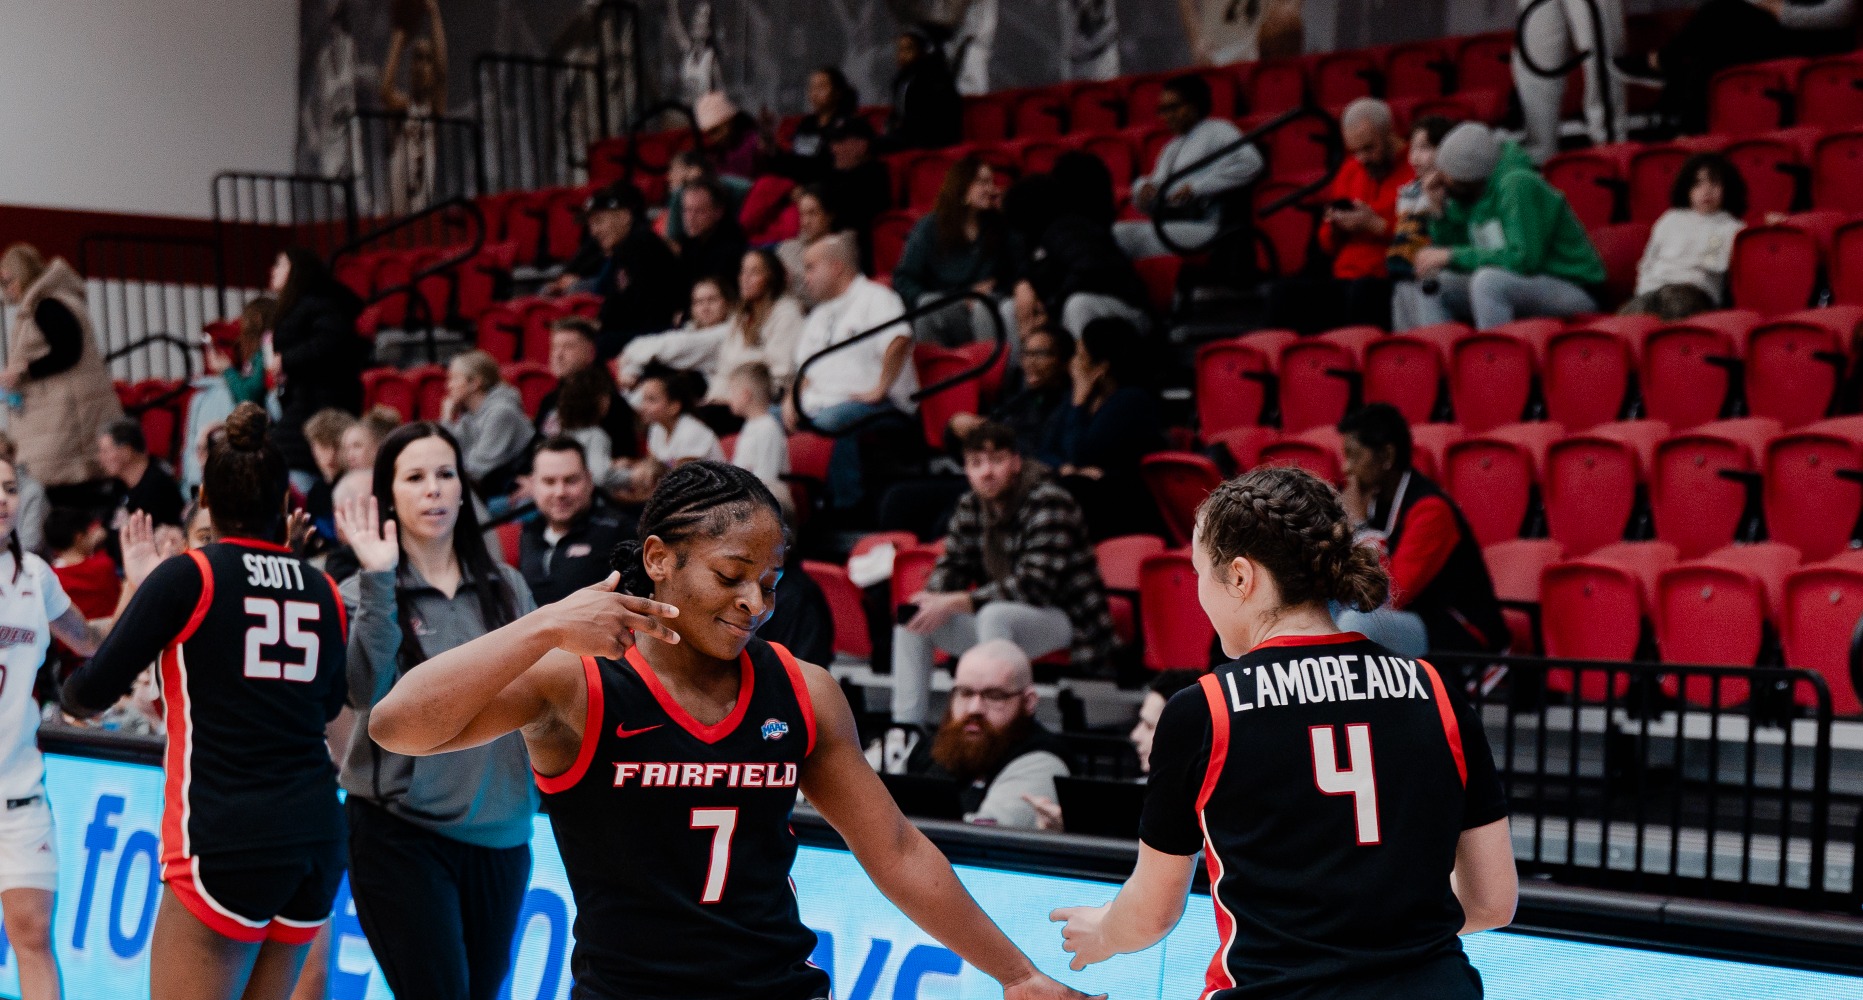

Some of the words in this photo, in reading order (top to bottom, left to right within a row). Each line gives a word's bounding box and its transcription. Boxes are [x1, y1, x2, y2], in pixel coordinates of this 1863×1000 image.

[242, 553, 305, 591] SCOTT
[243, 596, 321, 683] 25
[1225, 655, 1429, 712] L'AMOREAUX
[762, 721, 788, 738] MAAC
[612, 762, 797, 788] FAIRFIELD
[1308, 723, 1382, 846] 4
[72, 794, 160, 959] fo
[690, 806, 739, 904] 7
